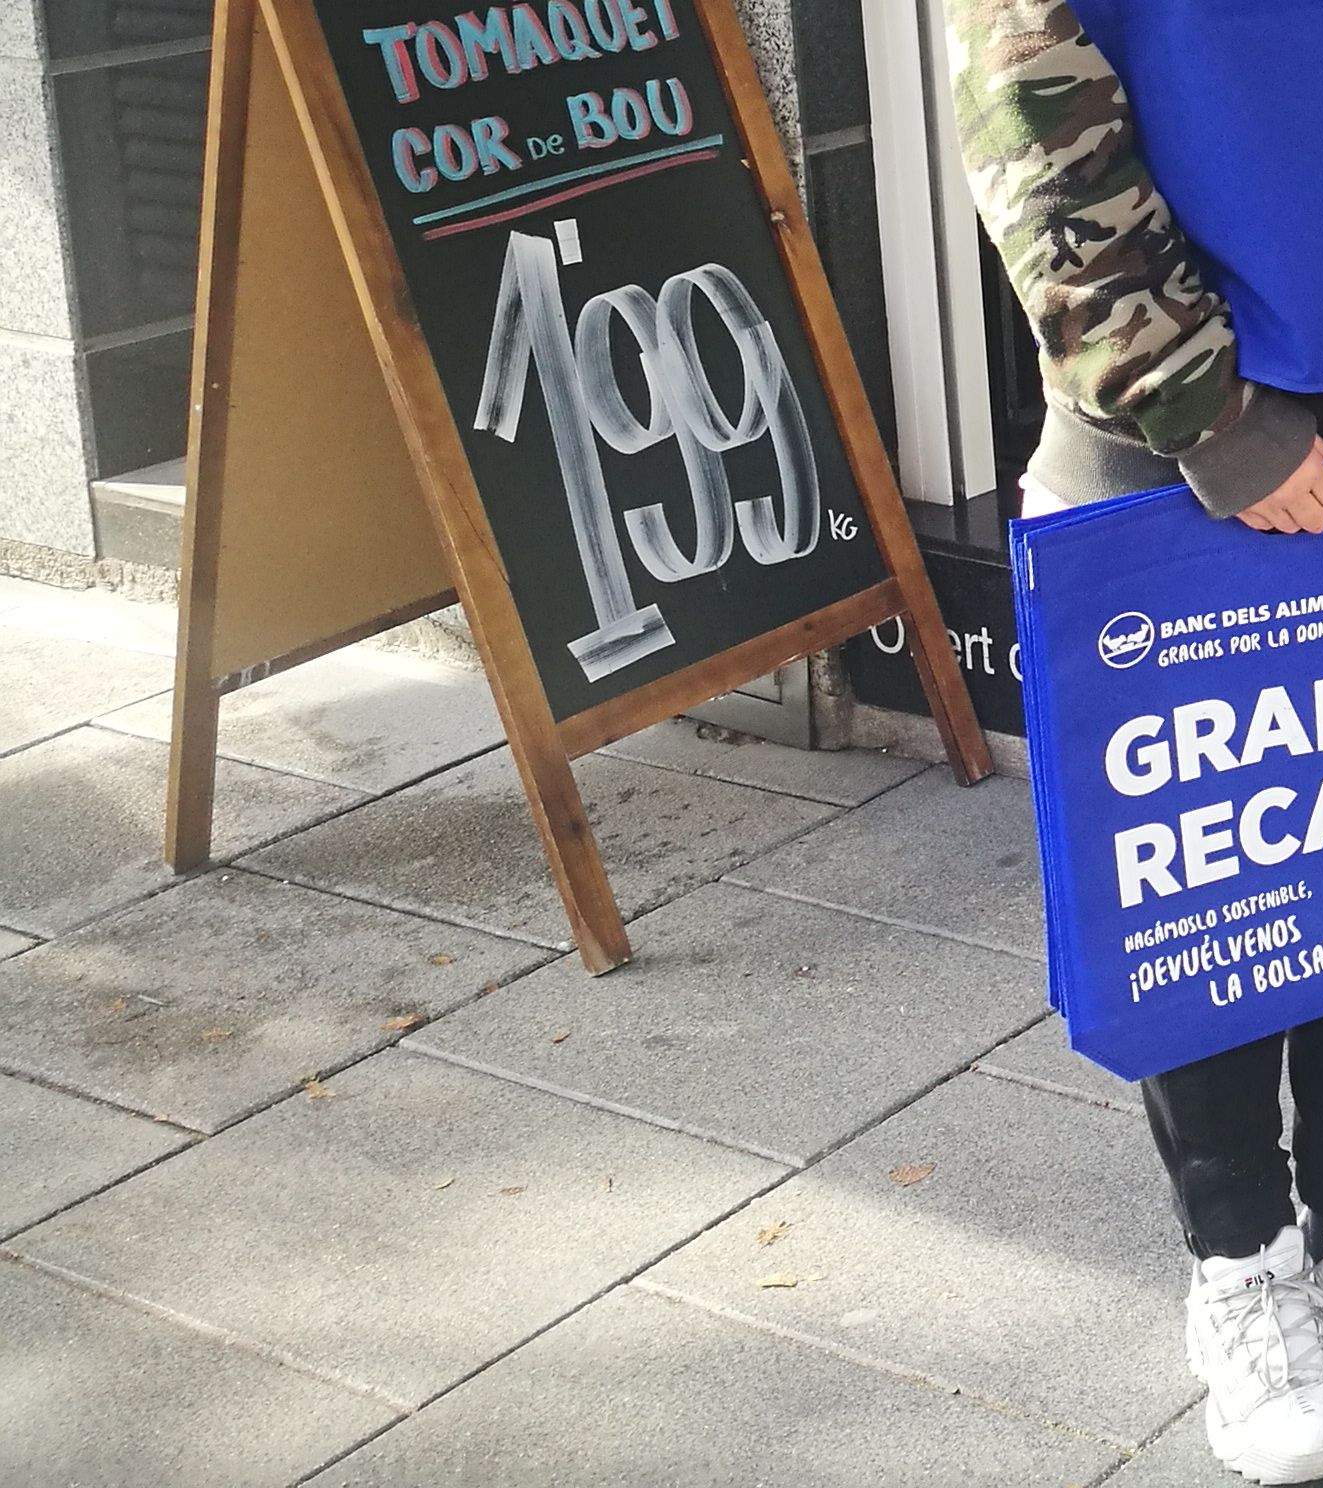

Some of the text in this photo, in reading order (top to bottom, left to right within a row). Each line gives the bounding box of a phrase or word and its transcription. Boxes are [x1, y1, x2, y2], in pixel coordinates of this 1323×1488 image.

[392, 115, 523, 193] COR
[567, 77, 694, 150] BOU
[828, 509, 858, 541] KG
[1160, 612, 1217, 639] BANC
[1222, 604, 1271, 628] DELS
[1158, 639, 1224, 667] GRACIAS
[1230, 632, 1261, 654] POR
[1267, 628, 1290, 648] LA
[1124, 909, 1218, 954] HAGÁMOSLO
[1209, 973, 1243, 1006] LA
